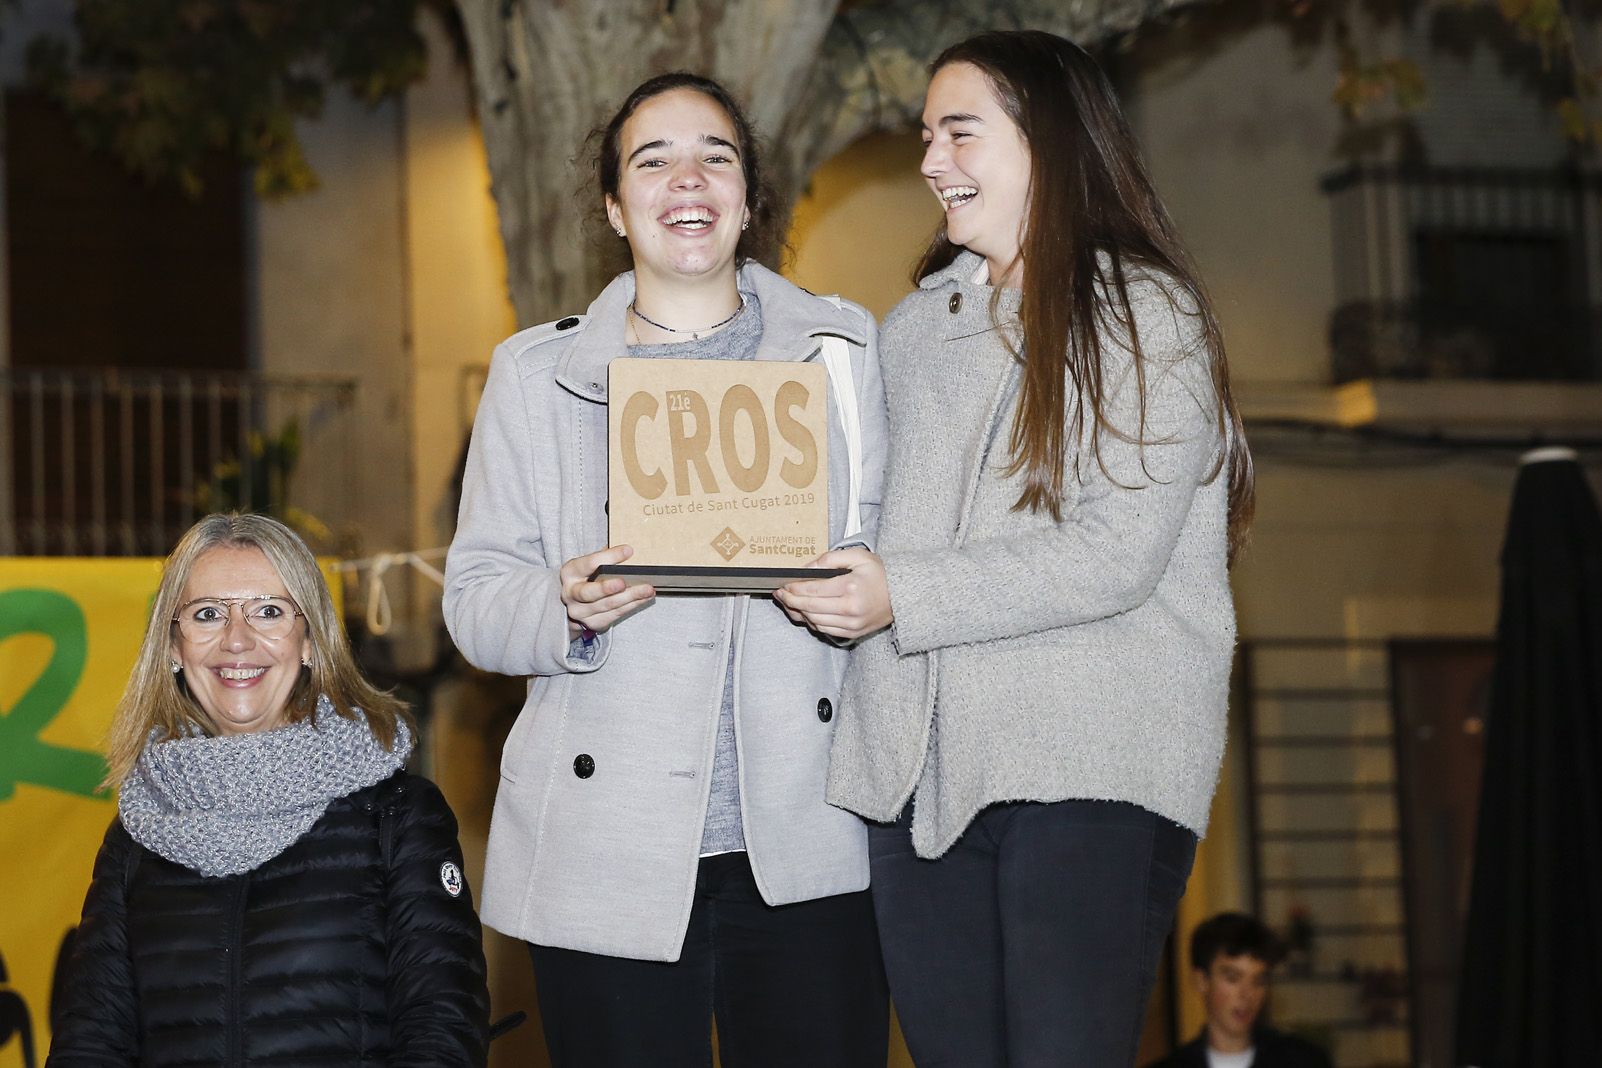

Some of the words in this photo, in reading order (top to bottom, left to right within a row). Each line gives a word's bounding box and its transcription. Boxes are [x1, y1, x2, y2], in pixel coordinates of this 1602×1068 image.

[620, 380, 818, 500] CROS
[643, 503, 684, 517] Ciutat
[687, 501, 704, 513] de
[707, 499, 738, 511] Sant
[741, 495, 781, 510] Cugat
[784, 492, 815, 506] 2019
[749, 536, 803, 544] AJUNTAMENT
[805, 536, 816, 544] DE
[749, 544, 817, 557] SantCugat
